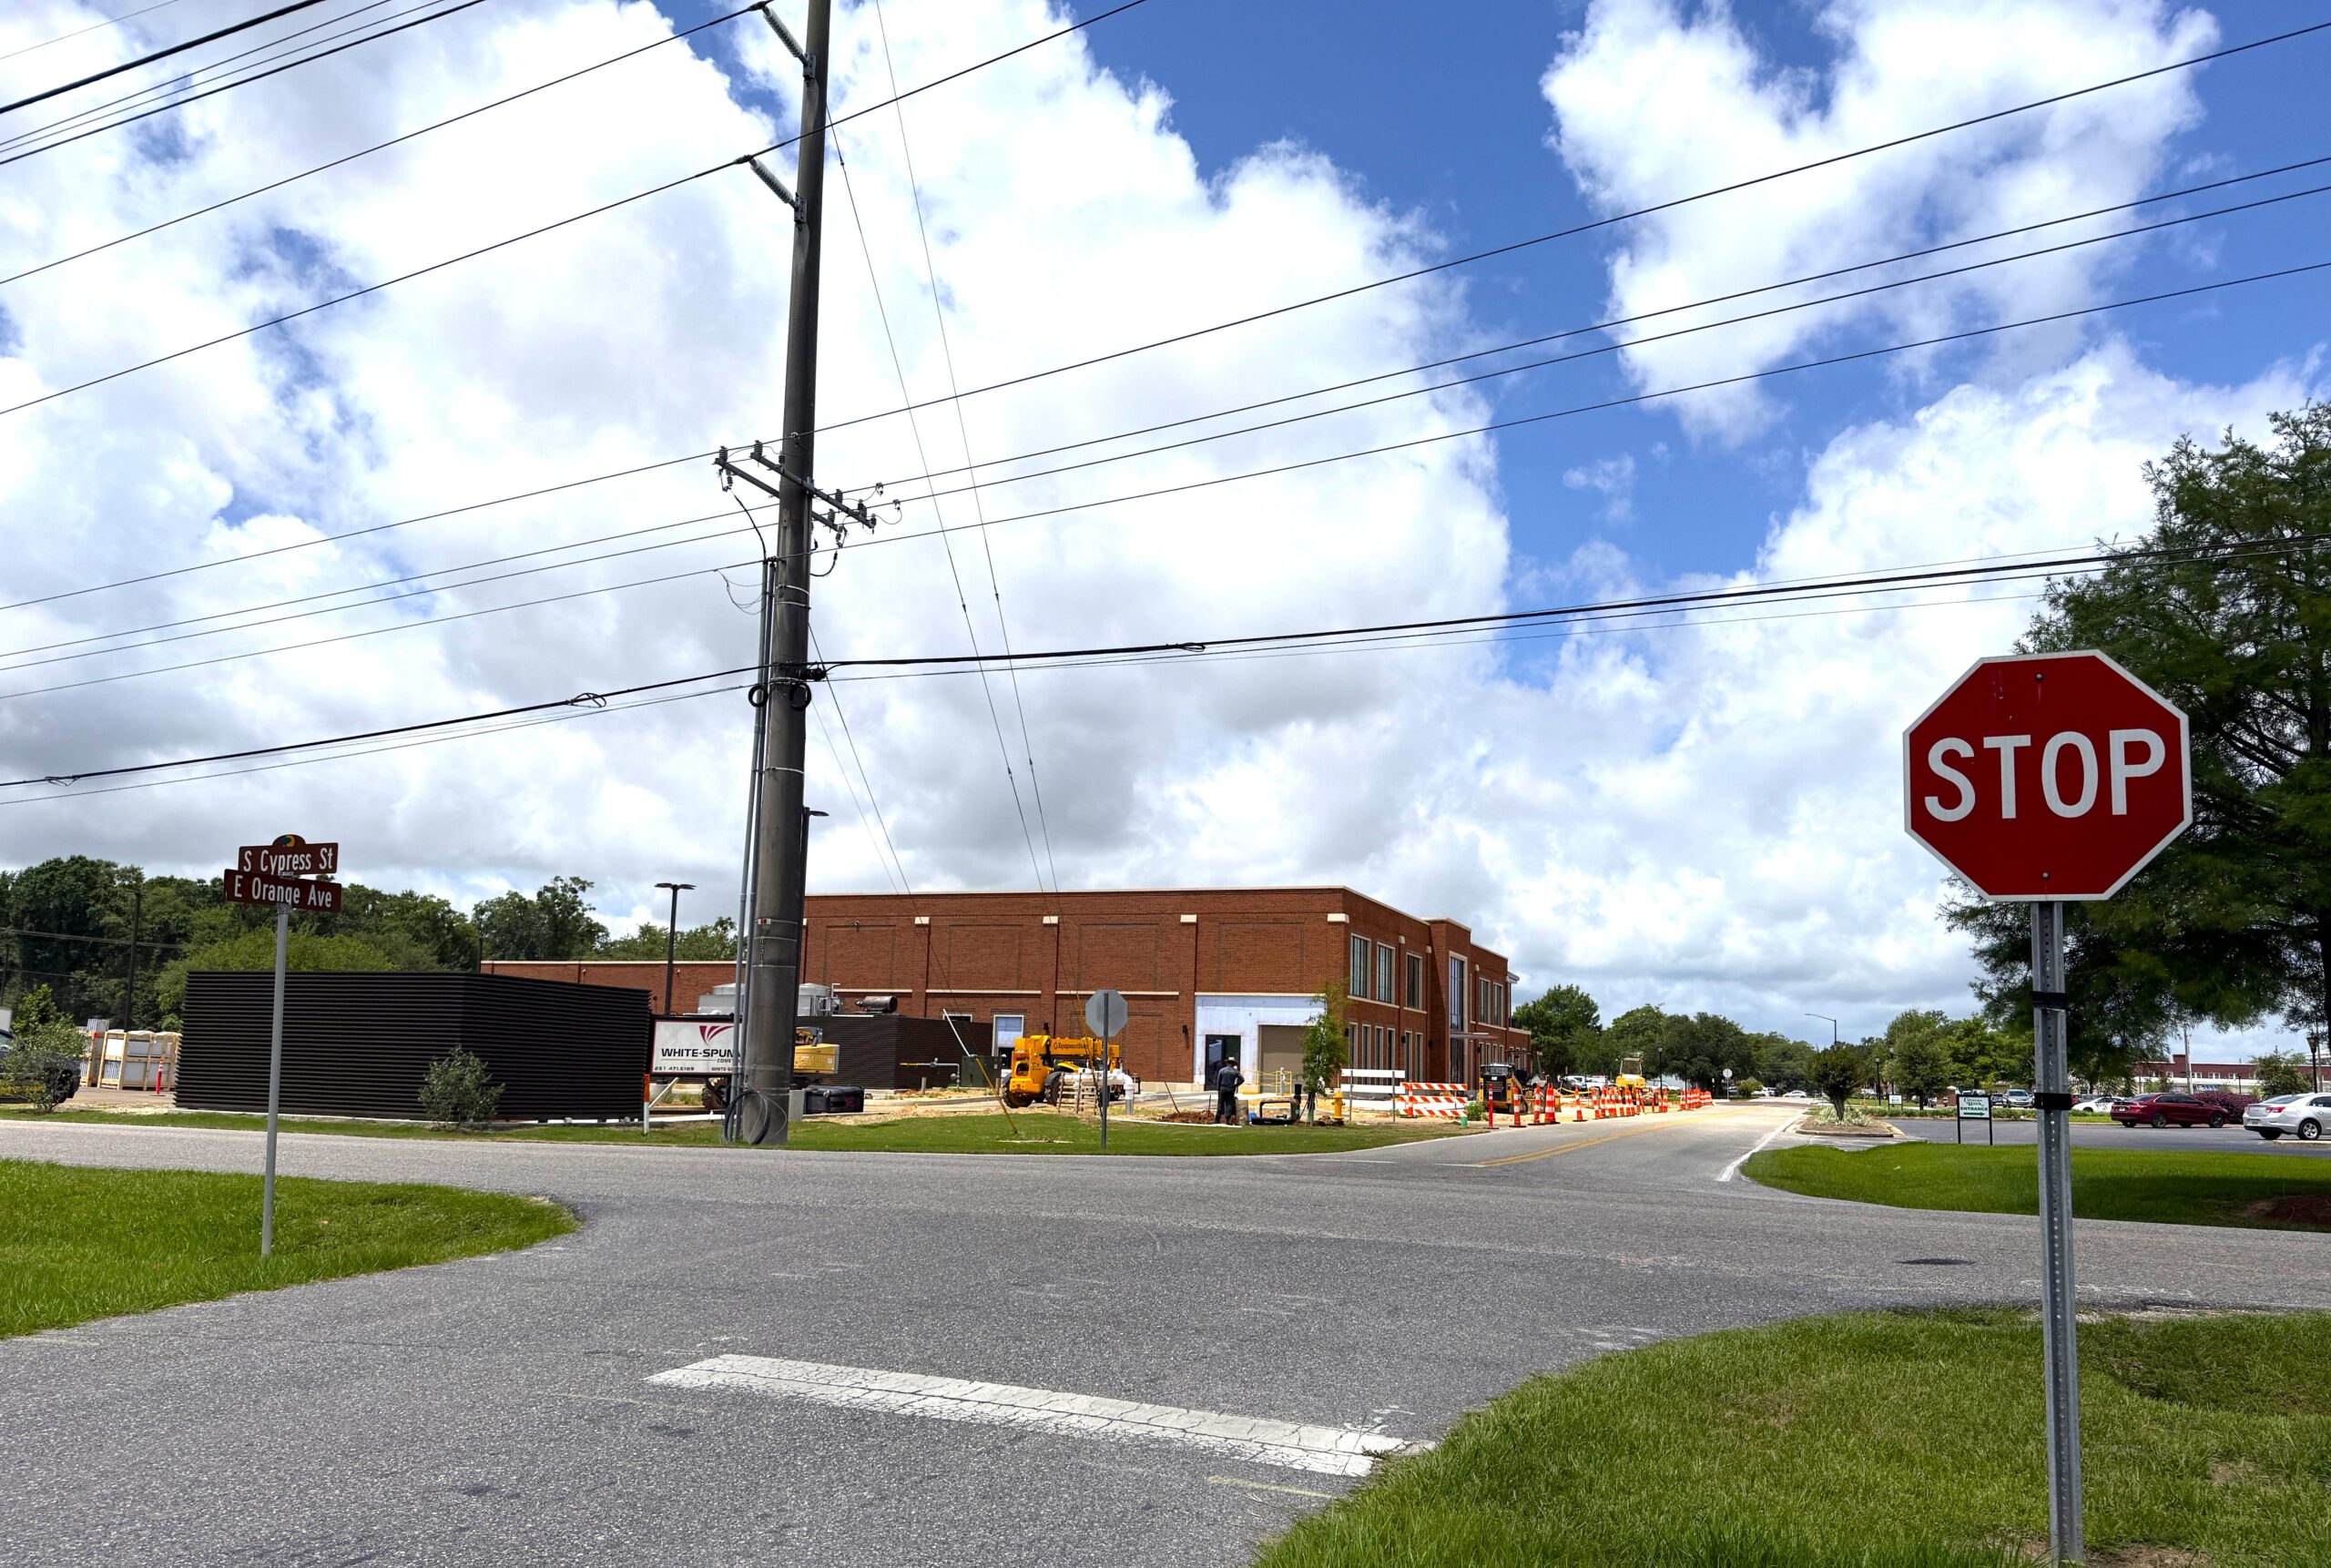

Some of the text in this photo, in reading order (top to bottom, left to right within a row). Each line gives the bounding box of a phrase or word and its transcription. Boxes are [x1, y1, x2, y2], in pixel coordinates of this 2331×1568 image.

[1924, 728, 2166, 822] STOP
[243, 847, 333, 876] S Cypress St
[234, 875, 332, 908] E Orange Ave
